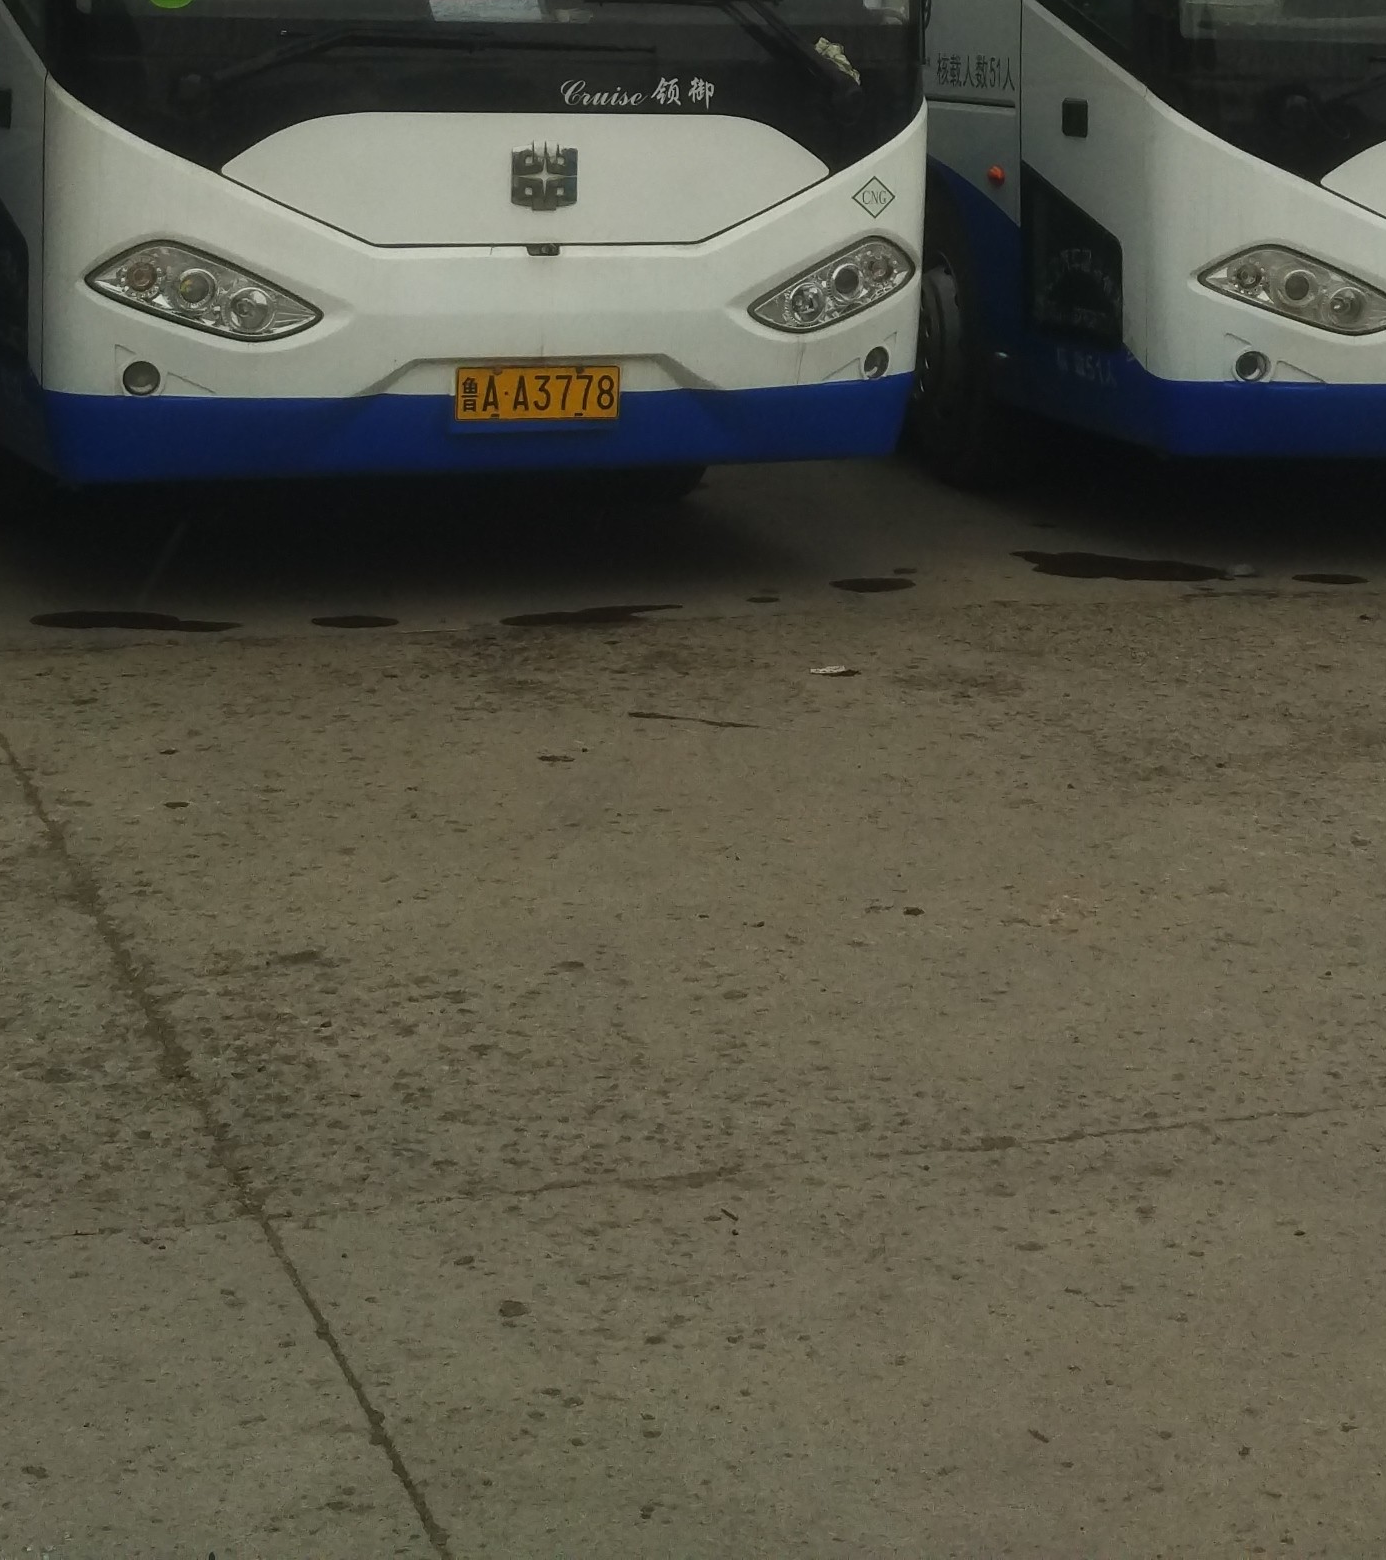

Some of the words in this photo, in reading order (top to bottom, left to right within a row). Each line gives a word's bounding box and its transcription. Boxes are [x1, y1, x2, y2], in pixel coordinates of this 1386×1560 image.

[936, 53, 1015, 91] 核载人数51人
[560, 79, 649, 106] Cruise
[650, 77, 715, 110] 领御
[862, 190, 886, 205] CNG
